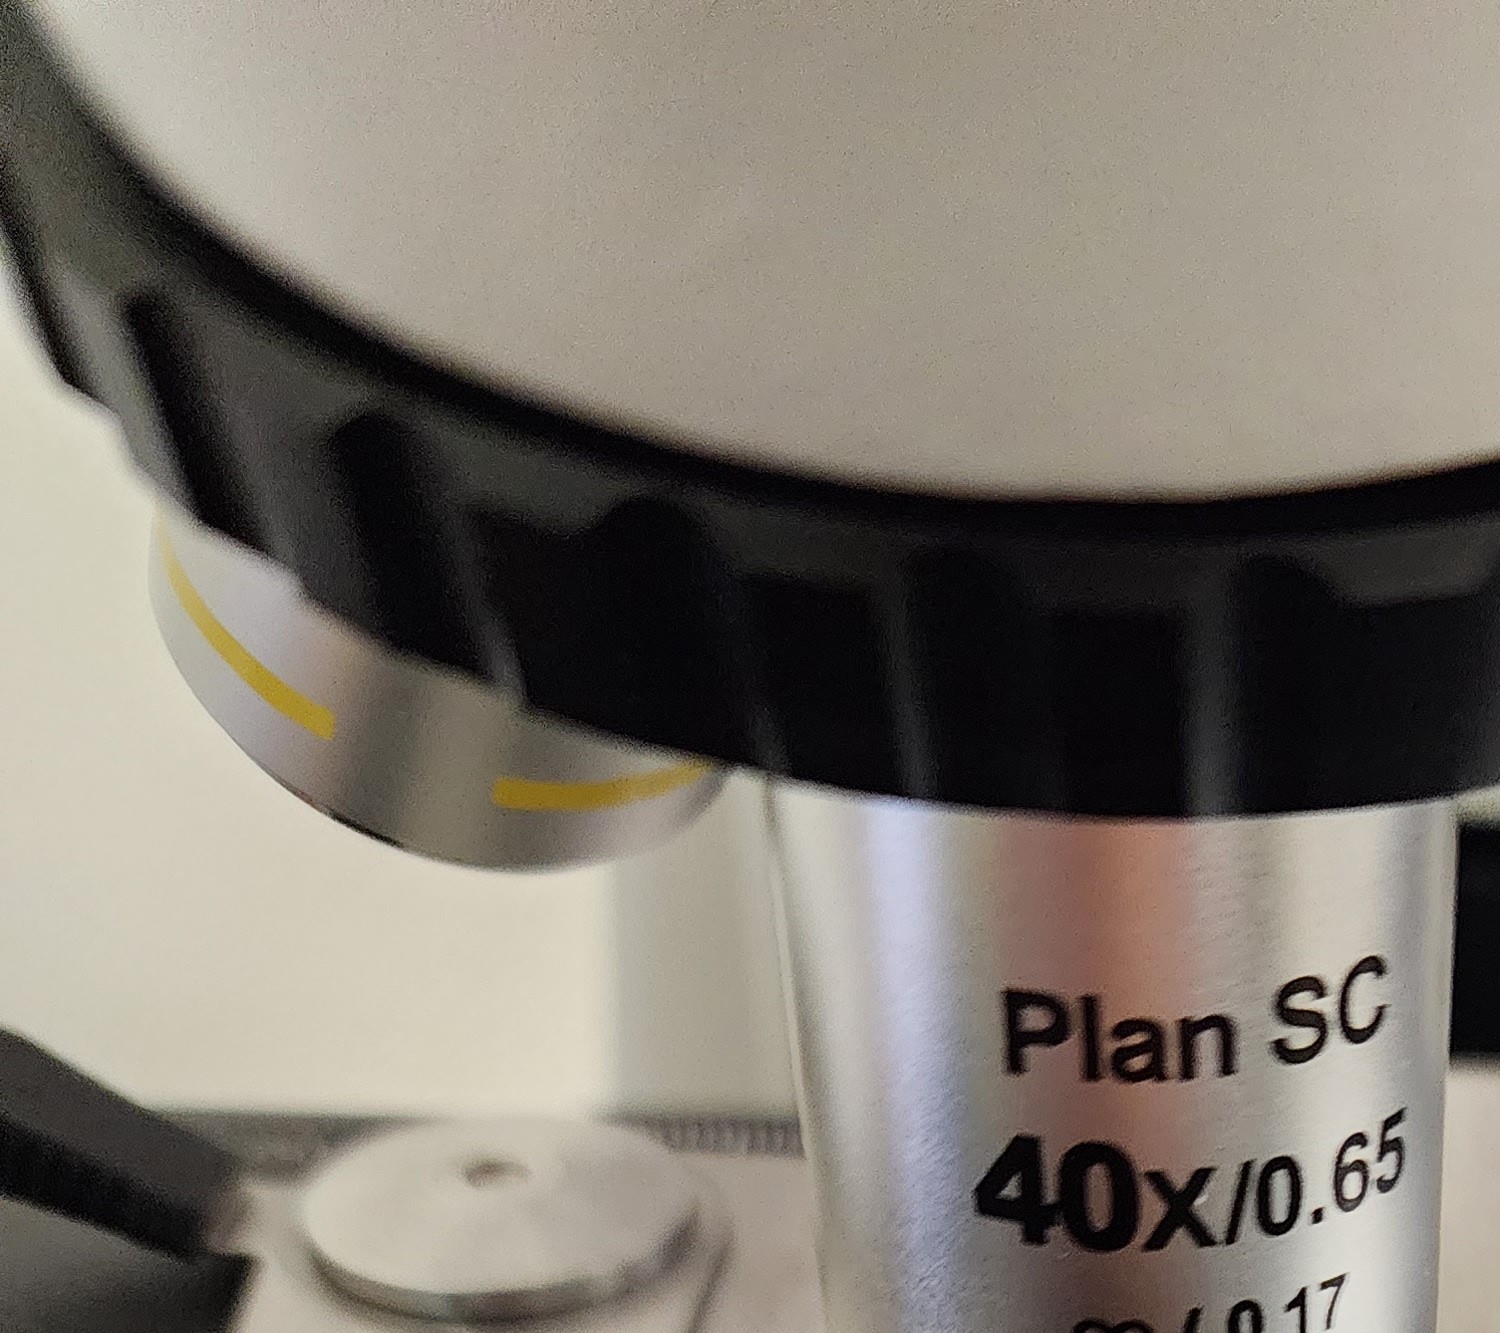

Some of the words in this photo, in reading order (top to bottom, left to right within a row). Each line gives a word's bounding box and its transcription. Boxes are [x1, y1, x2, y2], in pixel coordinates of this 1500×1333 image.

[1001, 987, 1238, 1083] Plan
[1270, 955, 1390, 1065] SC
[974, 1107, 1408, 1252] 40x/0.65
